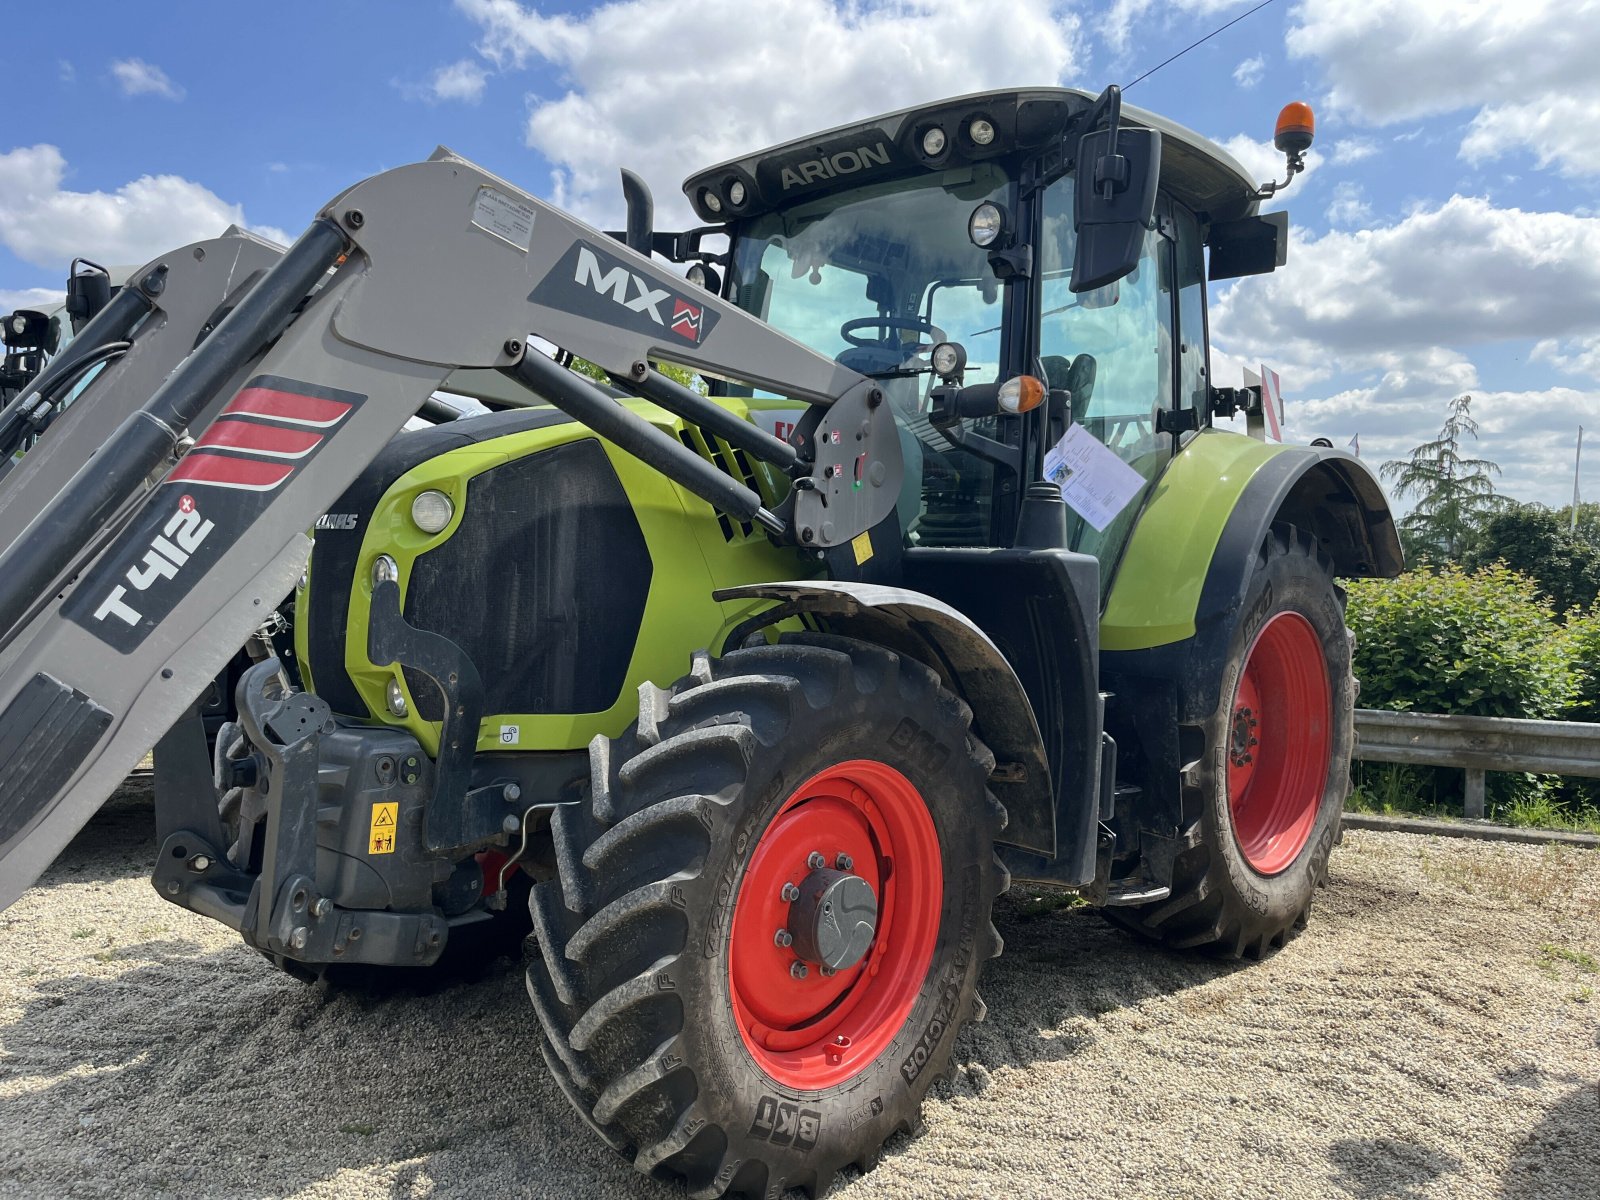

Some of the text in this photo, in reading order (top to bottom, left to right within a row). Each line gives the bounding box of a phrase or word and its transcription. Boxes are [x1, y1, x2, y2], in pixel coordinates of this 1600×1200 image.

[781, 142, 890, 190] ARION
[575, 247, 671, 326] MX
[755, 1102, 821, 1143] BKT
